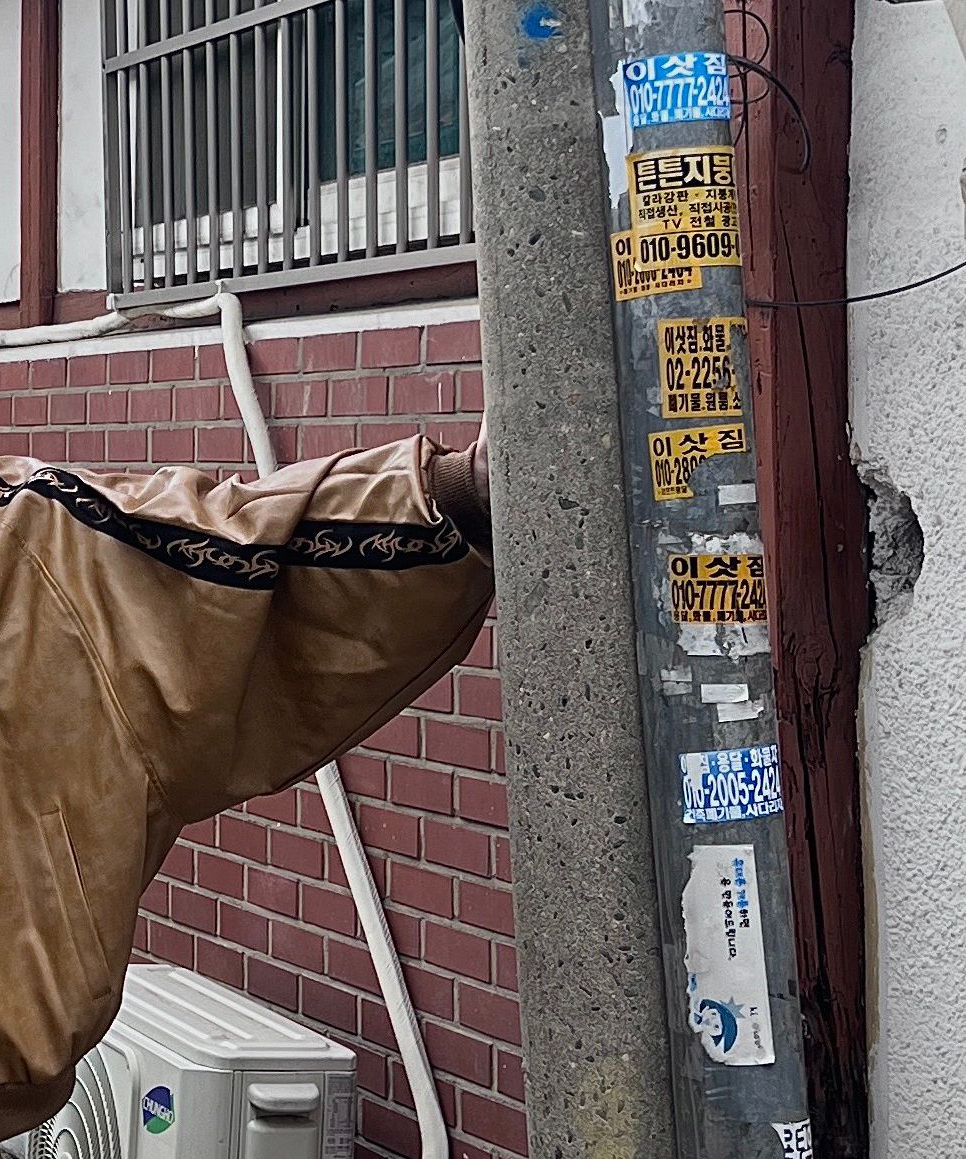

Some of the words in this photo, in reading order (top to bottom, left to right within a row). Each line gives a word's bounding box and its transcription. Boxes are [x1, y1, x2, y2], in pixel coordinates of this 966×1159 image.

[637, 155, 732, 191] 튼튼지붕
[642, 190, 689, 206] 칼라강판
[662, 219, 682, 229] TV
